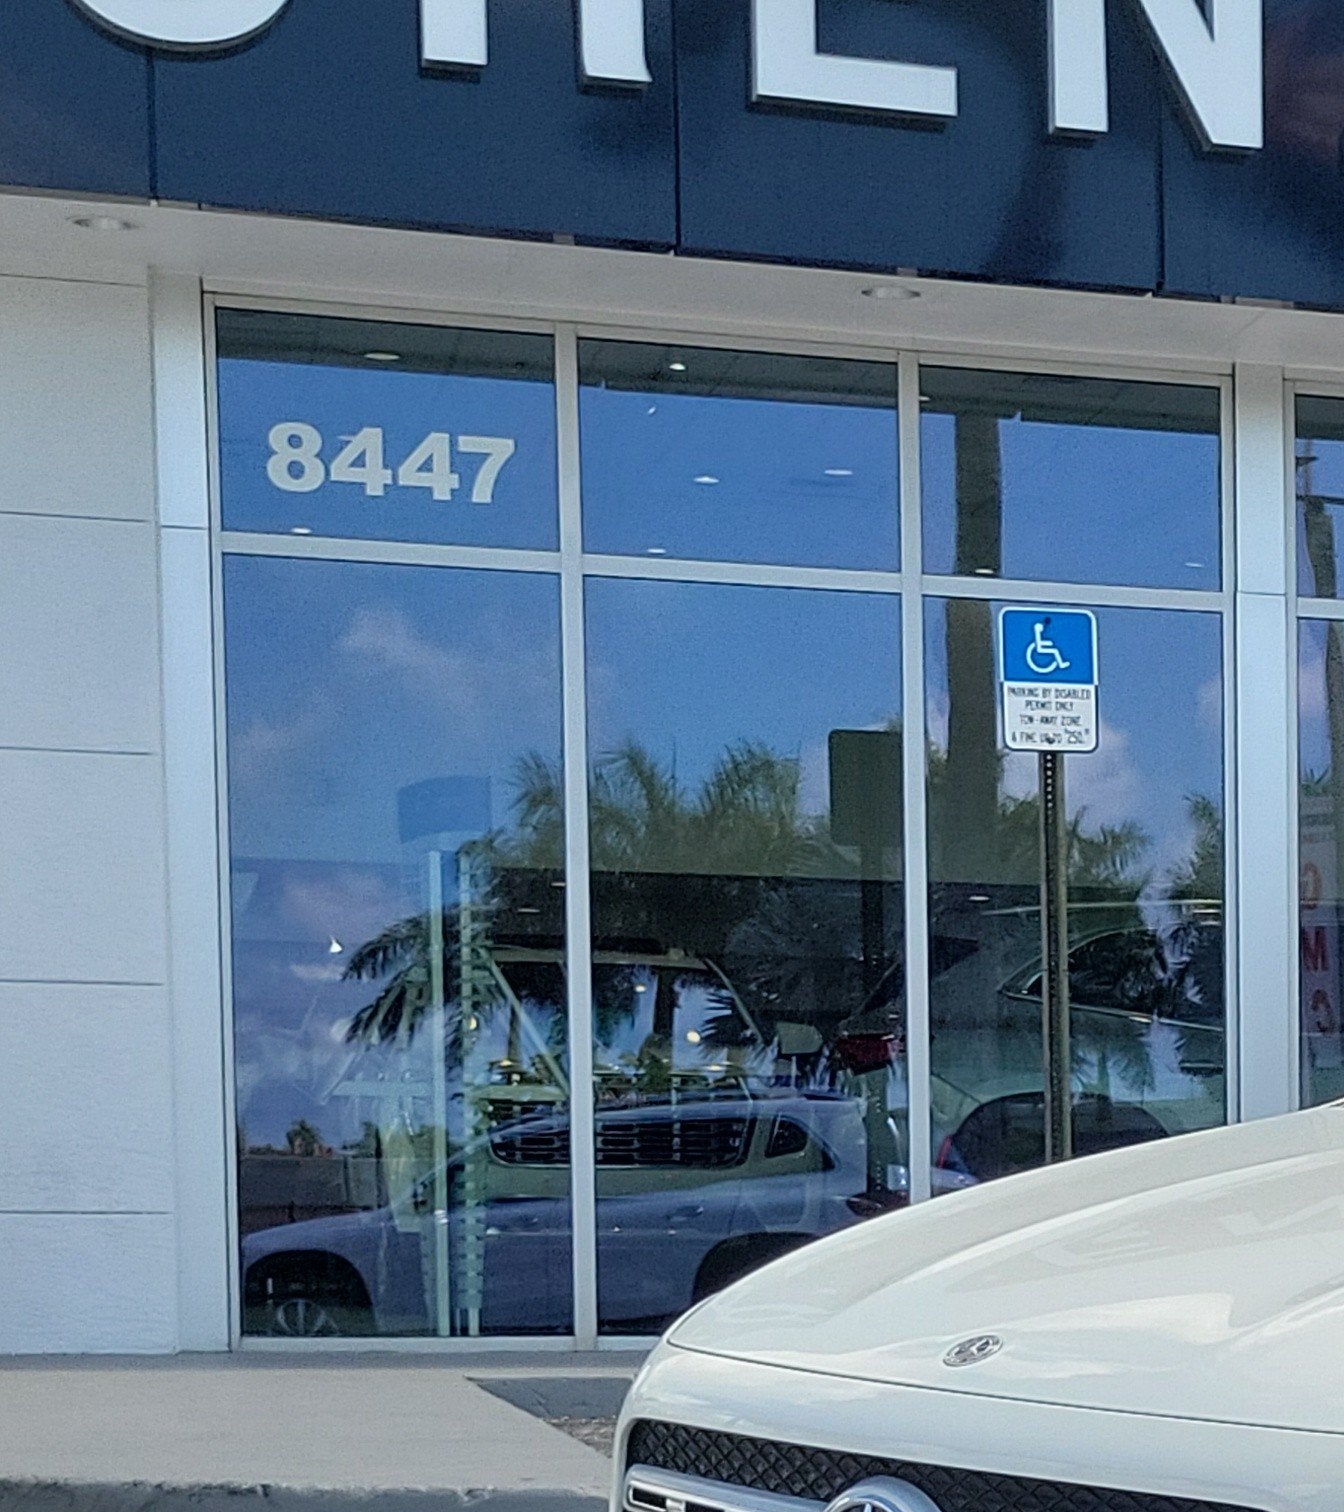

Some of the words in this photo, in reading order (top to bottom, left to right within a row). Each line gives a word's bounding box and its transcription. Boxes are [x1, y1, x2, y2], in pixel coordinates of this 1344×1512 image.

[266, 422, 516, 504] 8447
[1007, 687, 1038, 698] PARKING
[1042, 688, 1052, 699] BY
[1055, 688, 1091, 700] DISABLED
[1025, 700, 1052, 711] PERMIT
[1055, 701, 1074, 711] ONLY
[1020, 732, 1037, 743] FINE
